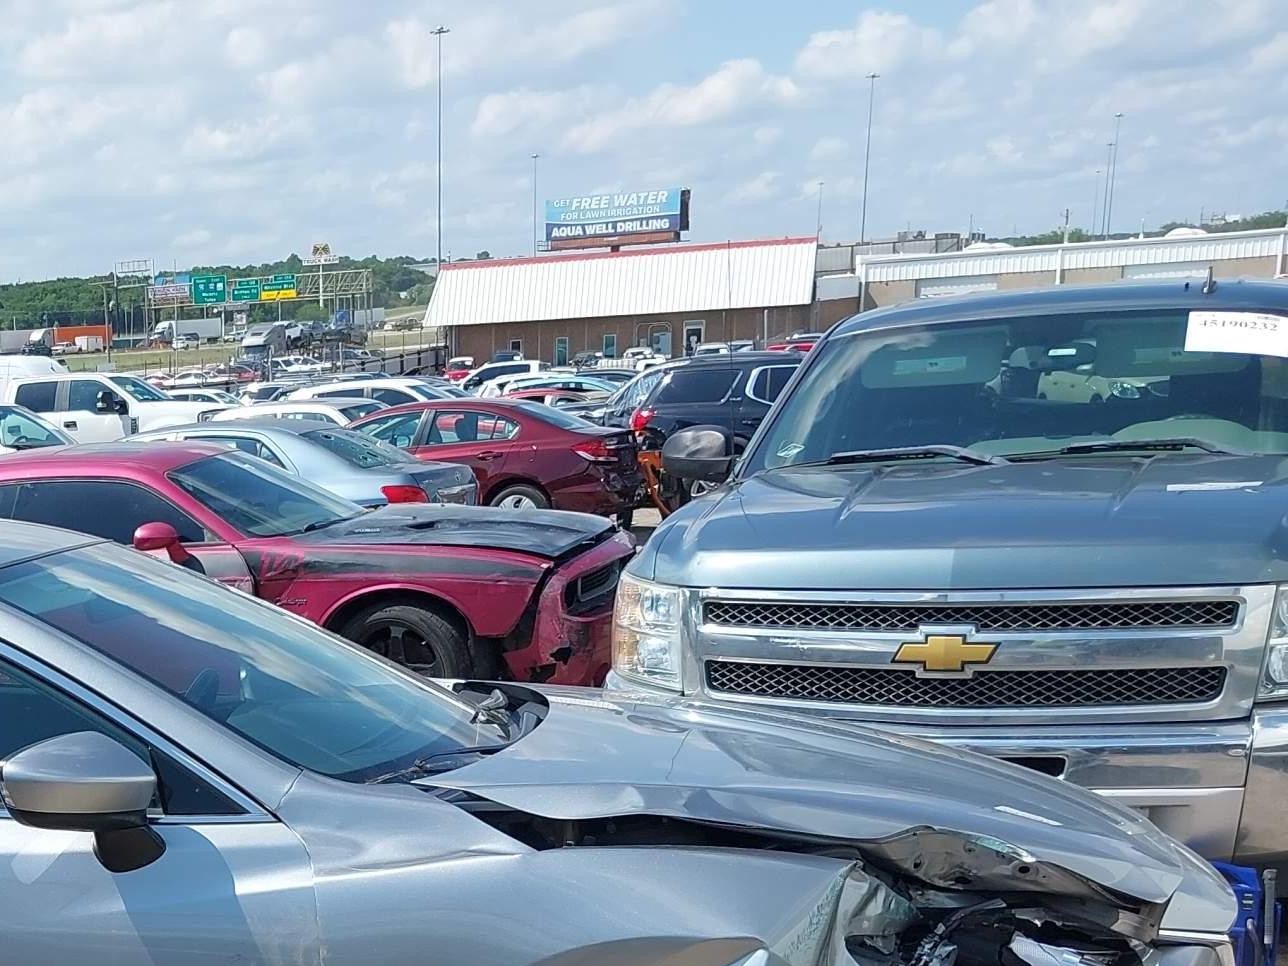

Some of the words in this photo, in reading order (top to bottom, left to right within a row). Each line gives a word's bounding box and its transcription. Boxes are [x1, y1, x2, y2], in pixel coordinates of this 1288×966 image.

[553, 199, 570, 208] GET
[571, 195, 611, 211] FREE
[615, 191, 668, 207] WATER
[560, 212, 578, 221] FOR
[580, 209, 606, 219] LAWN
[607, 205, 660, 217] IRRIGATION
[552, 226, 584, 237] AQUA
[585, 223, 615, 235] WELL
[616, 219, 669, 232] DRILLING
